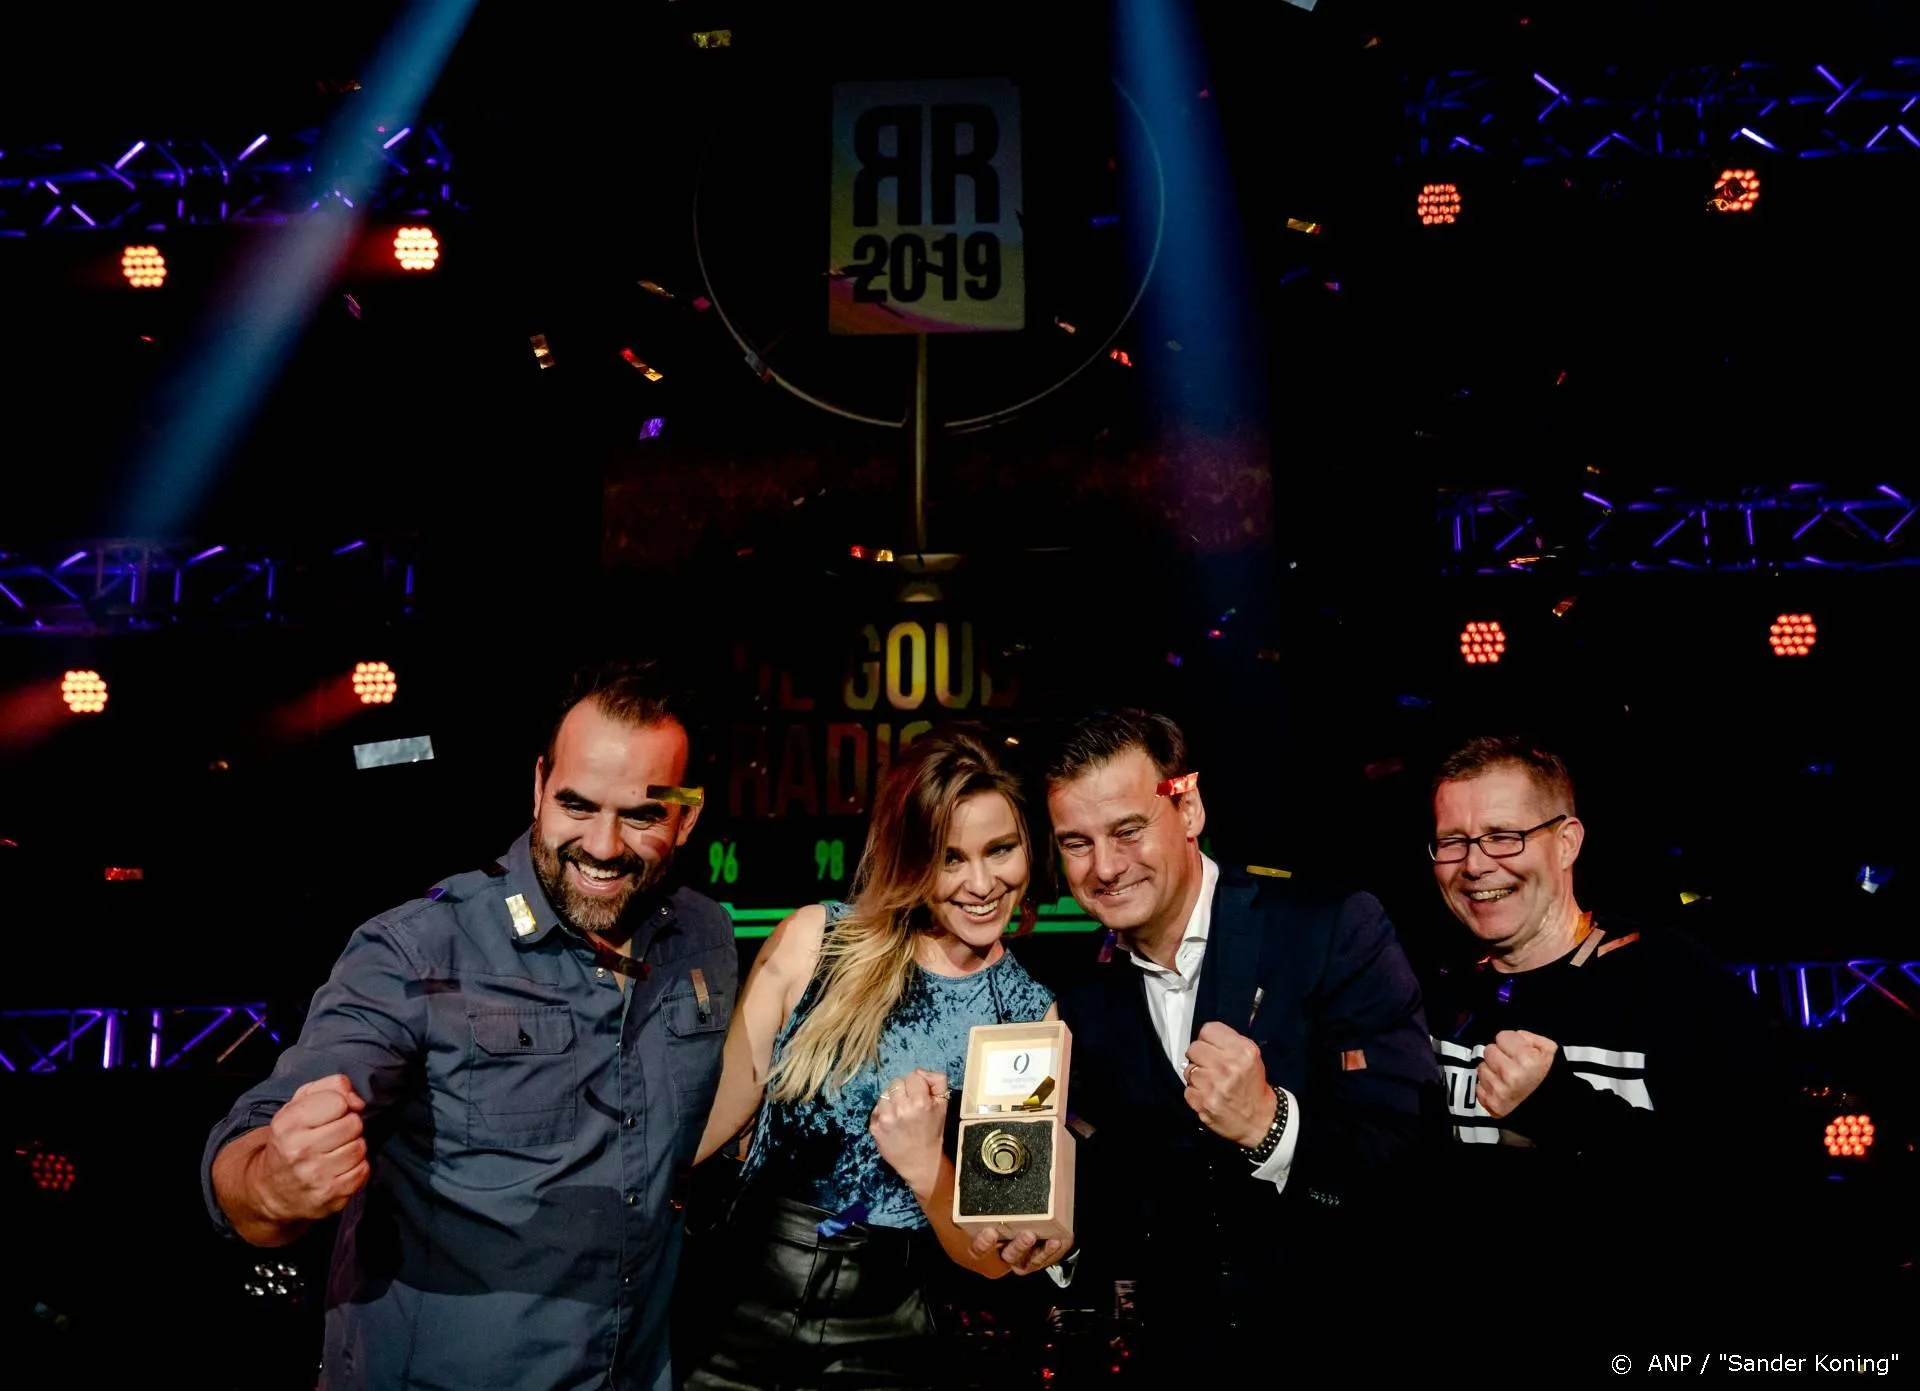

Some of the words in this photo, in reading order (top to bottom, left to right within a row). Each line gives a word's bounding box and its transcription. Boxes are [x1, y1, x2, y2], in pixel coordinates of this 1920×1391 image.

[852, 231, 1001, 304] 2019
[727, 718, 935, 822] RADI
[707, 838, 741, 887] 96
[813, 837, 849, 885] 98
